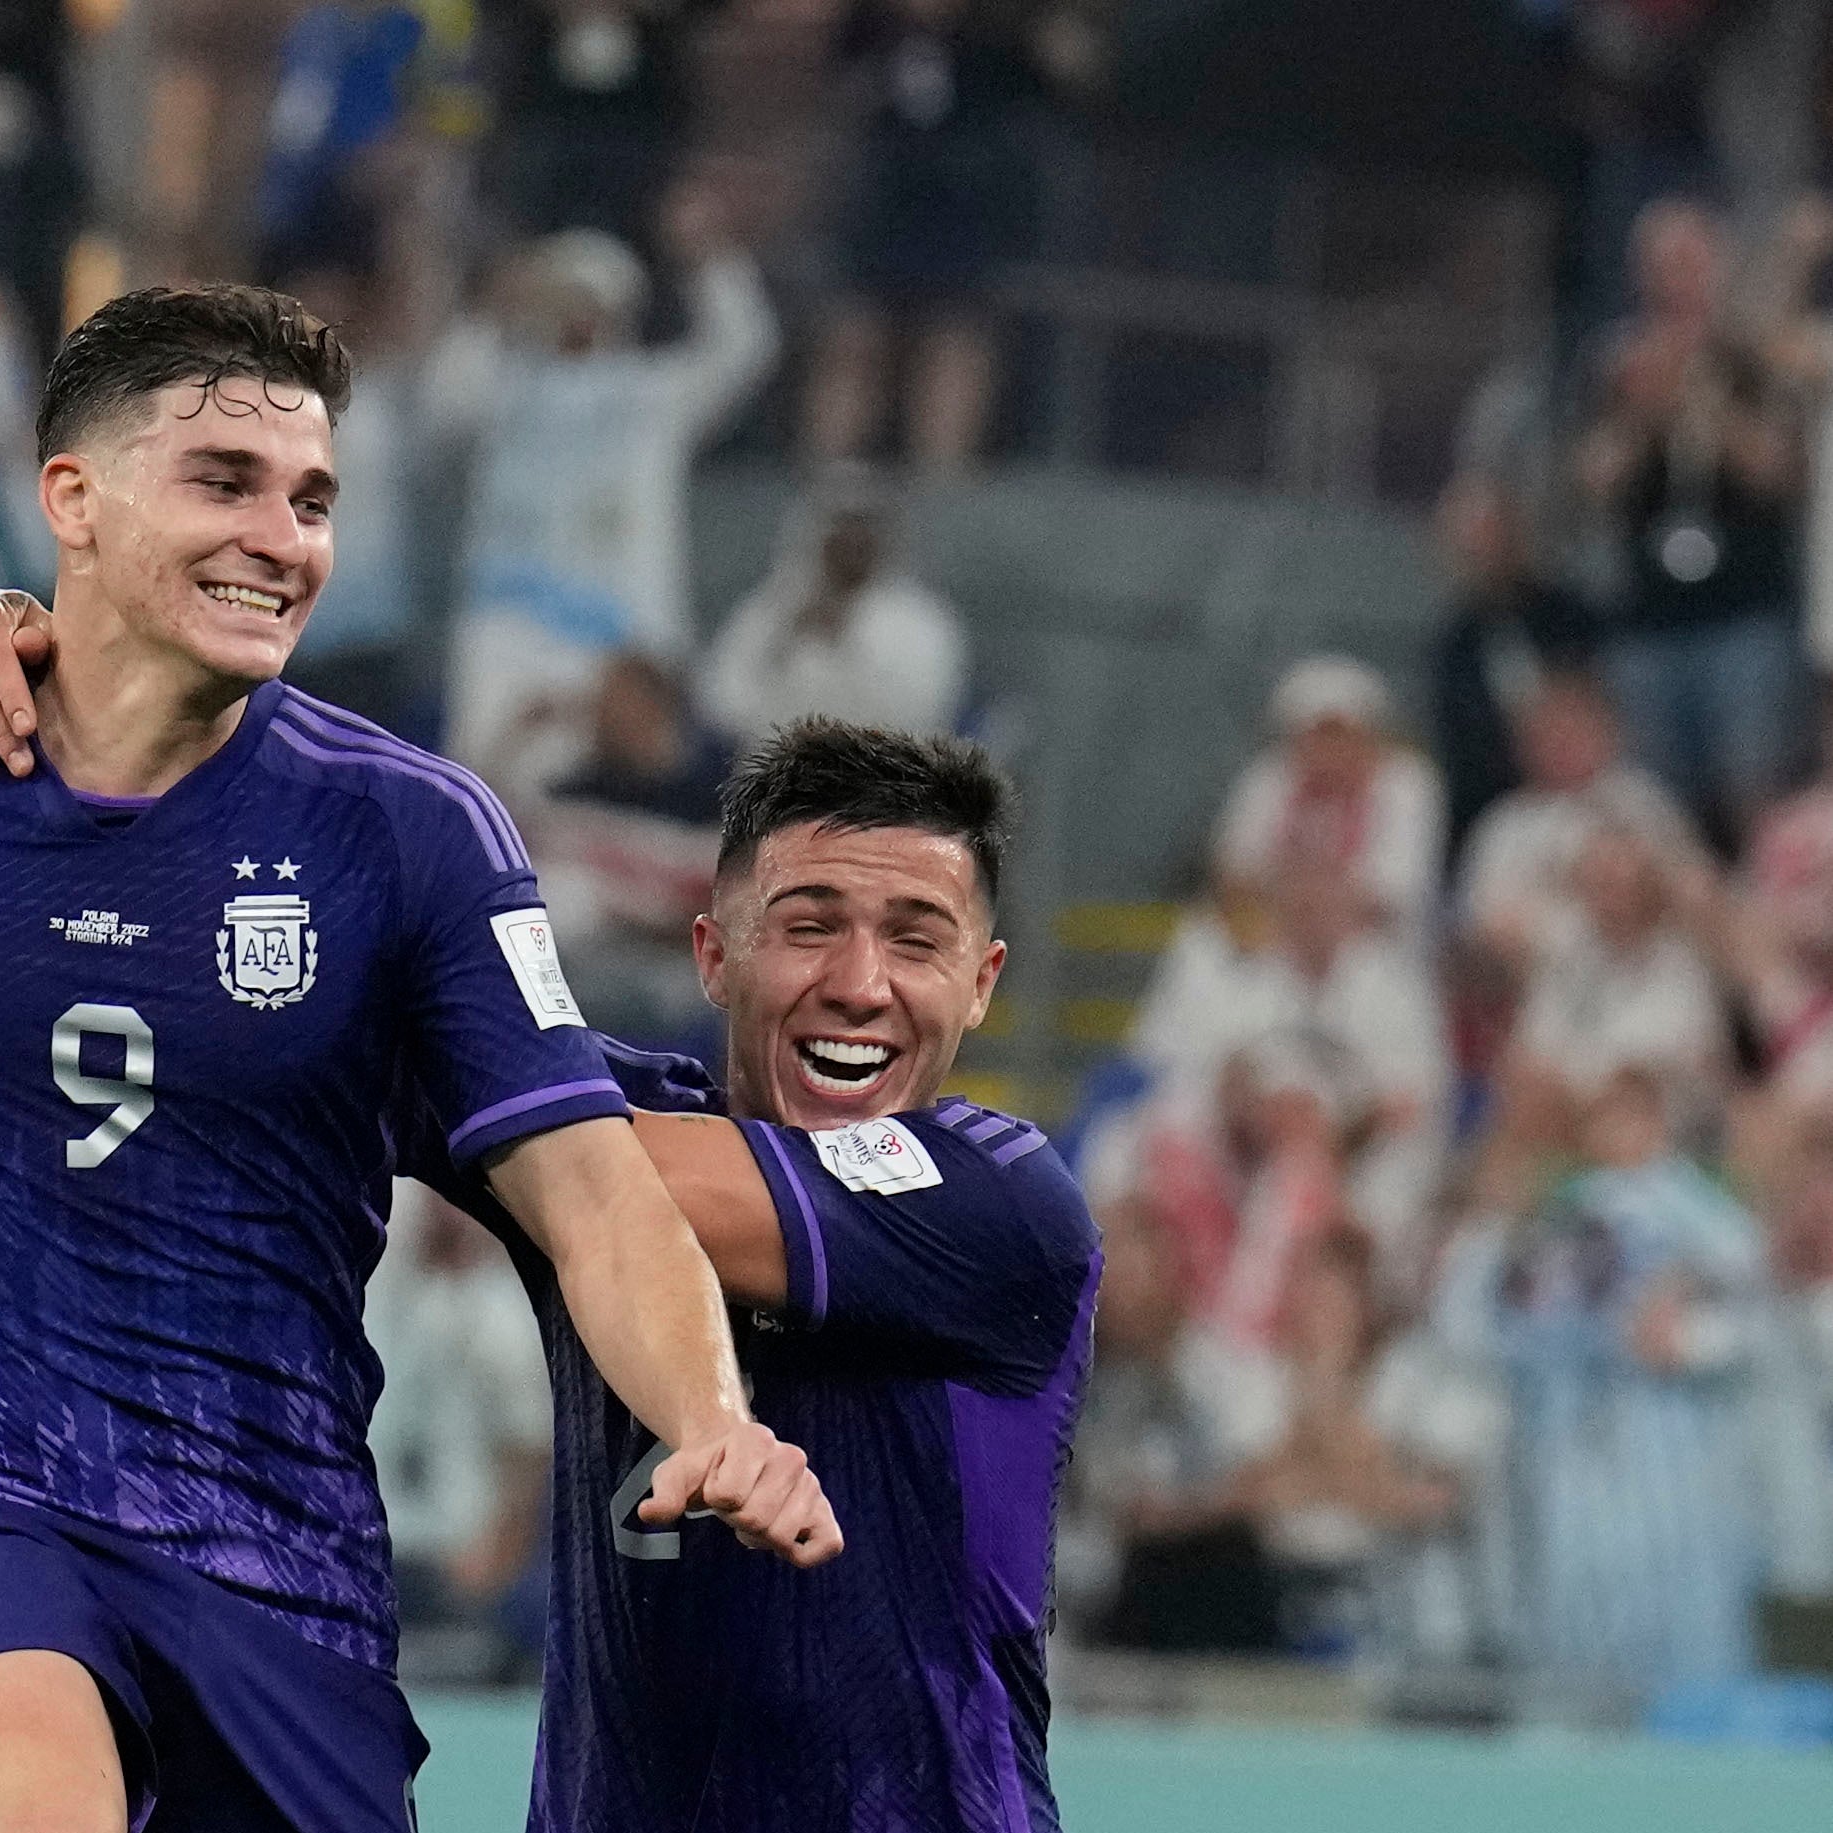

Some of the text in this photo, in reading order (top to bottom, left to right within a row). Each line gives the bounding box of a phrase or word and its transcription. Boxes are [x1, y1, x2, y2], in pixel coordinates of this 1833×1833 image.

[49, 917, 65, 930] 30
[121, 924, 150, 937] 2022
[82, 910, 119, 924] POLAND
[65, 930, 133, 946] STADIUM 974
[241, 925, 293, 975] AFA
[52, 1003, 155, 1168] 9
